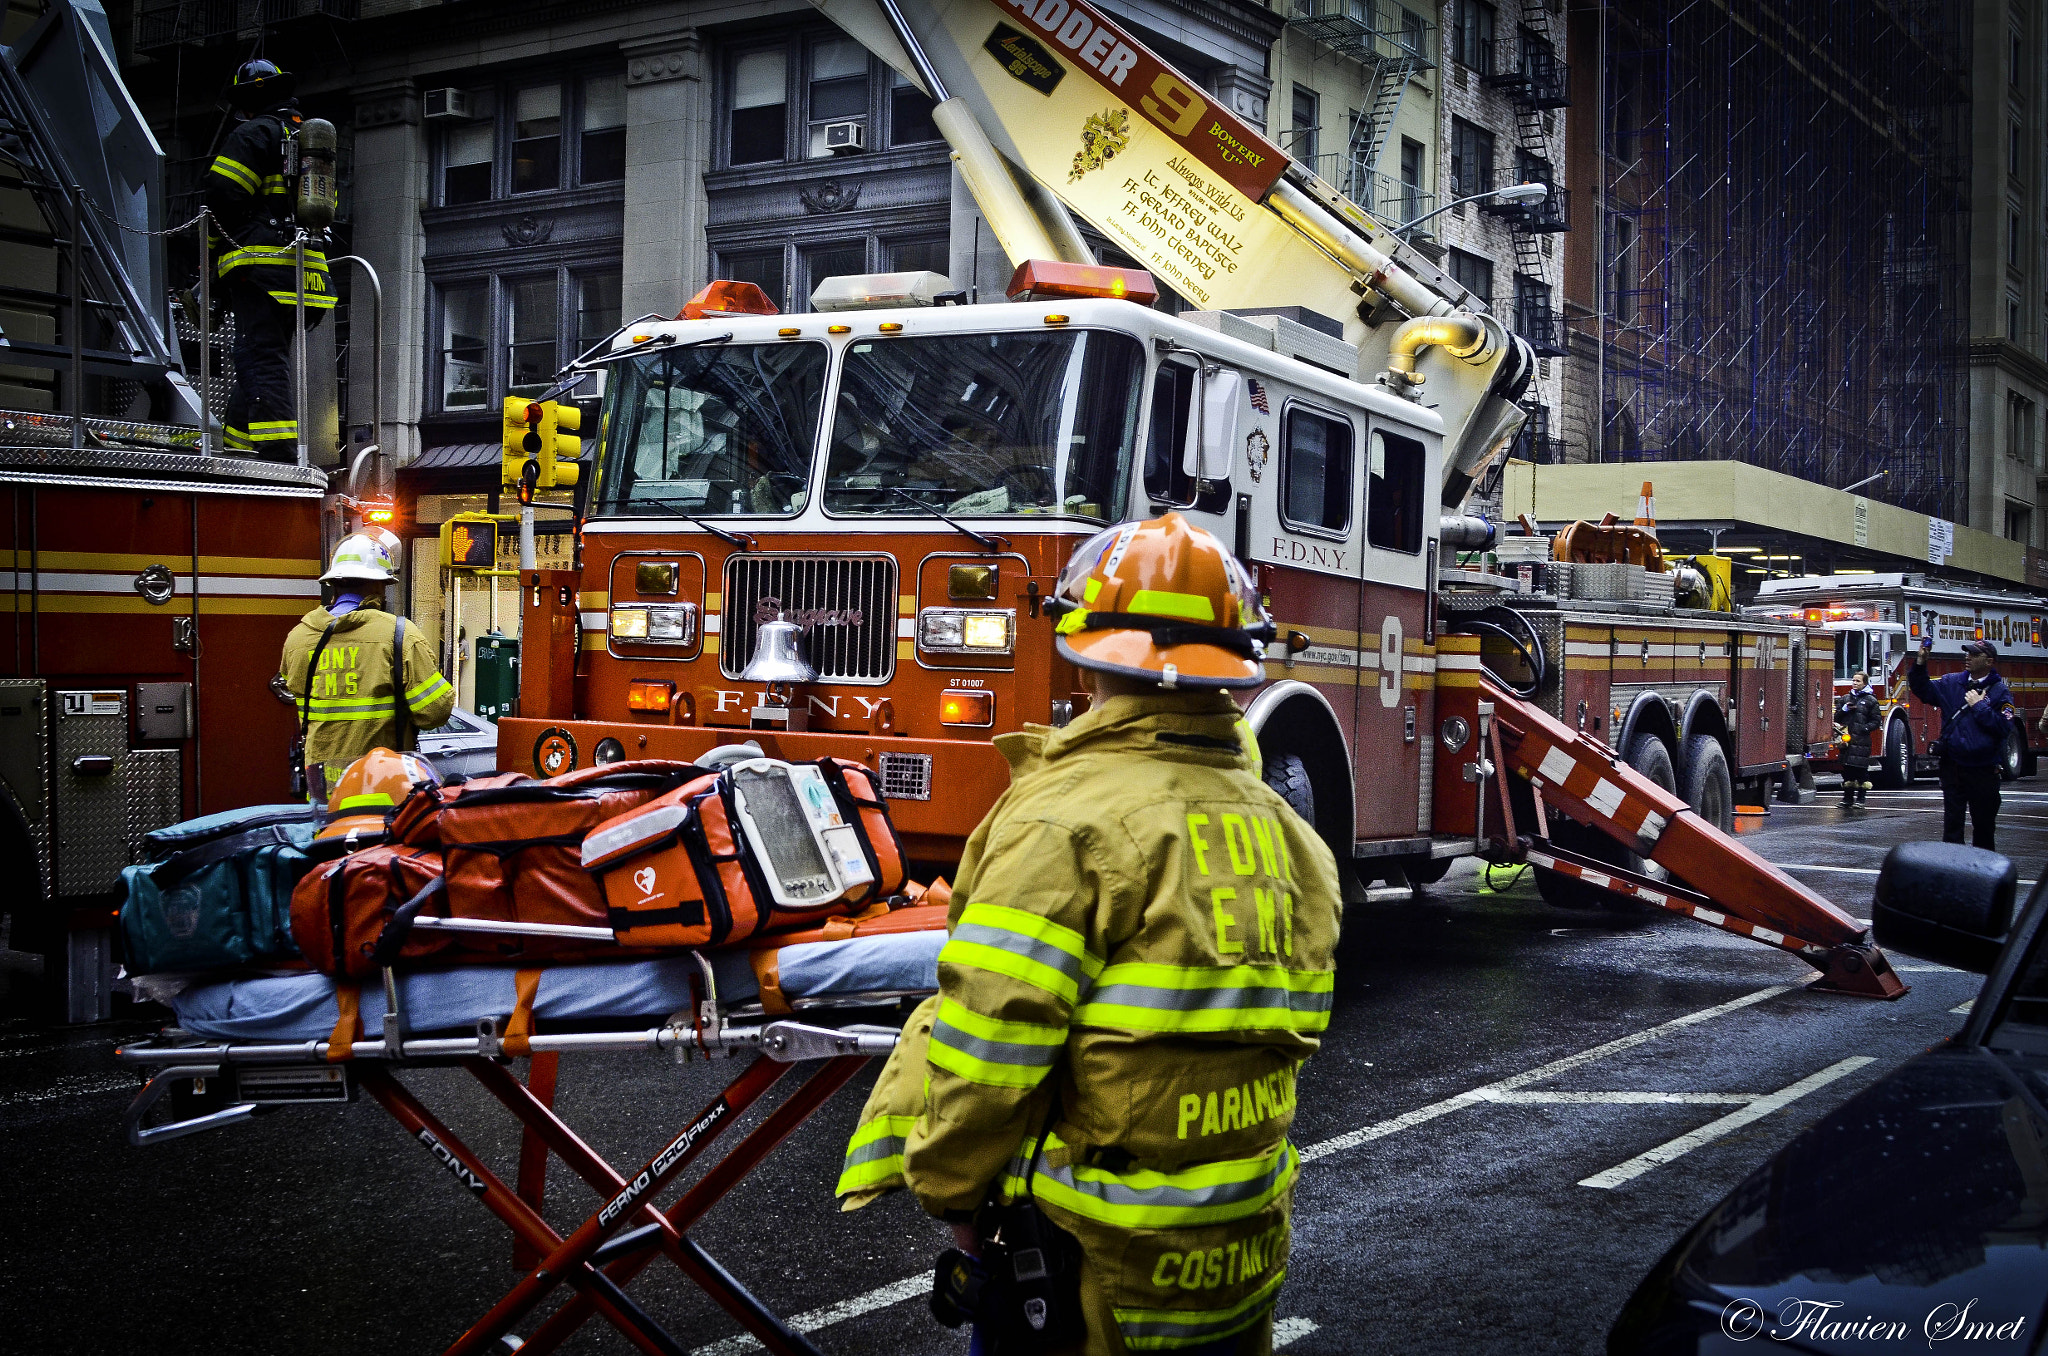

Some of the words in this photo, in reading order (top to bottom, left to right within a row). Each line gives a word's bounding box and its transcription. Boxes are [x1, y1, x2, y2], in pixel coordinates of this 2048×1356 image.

[1008, 59, 1028, 76] 95
[1140, 72, 1208, 137] 9
[1208, 121, 1265, 168] BOWERY
[302, 175, 310, 197] SCOTT
[318, 175, 326, 198] SCOTT
[1166, 157, 1204, 188] Always
[1206, 183, 1233, 209] With
[1230, 204, 1246, 222] Us
[1121, 178, 1140, 194] FF.
[1139, 191, 1186, 231] GERARD
[1185, 228, 1238, 274] BAPTISTE
[1121, 200, 1140, 217] FF.
[1167, 236, 1216, 280] TIERNEY
[1160, 184, 1207, 227] JEFFREY
[1207, 222, 1244, 255] WALZ
[1182, 276, 1210, 304] DEERY
[311, 672, 358, 698] EMS
[950, 678, 961, 688] ST
[961, 678, 984, 688] 01007
[1379, 615, 1403, 708] 9
[1177, 1063, 1298, 1140] PARAMED
[418, 1129, 487, 1191] FDNY
[597, 1170, 651, 1227] FERNO
